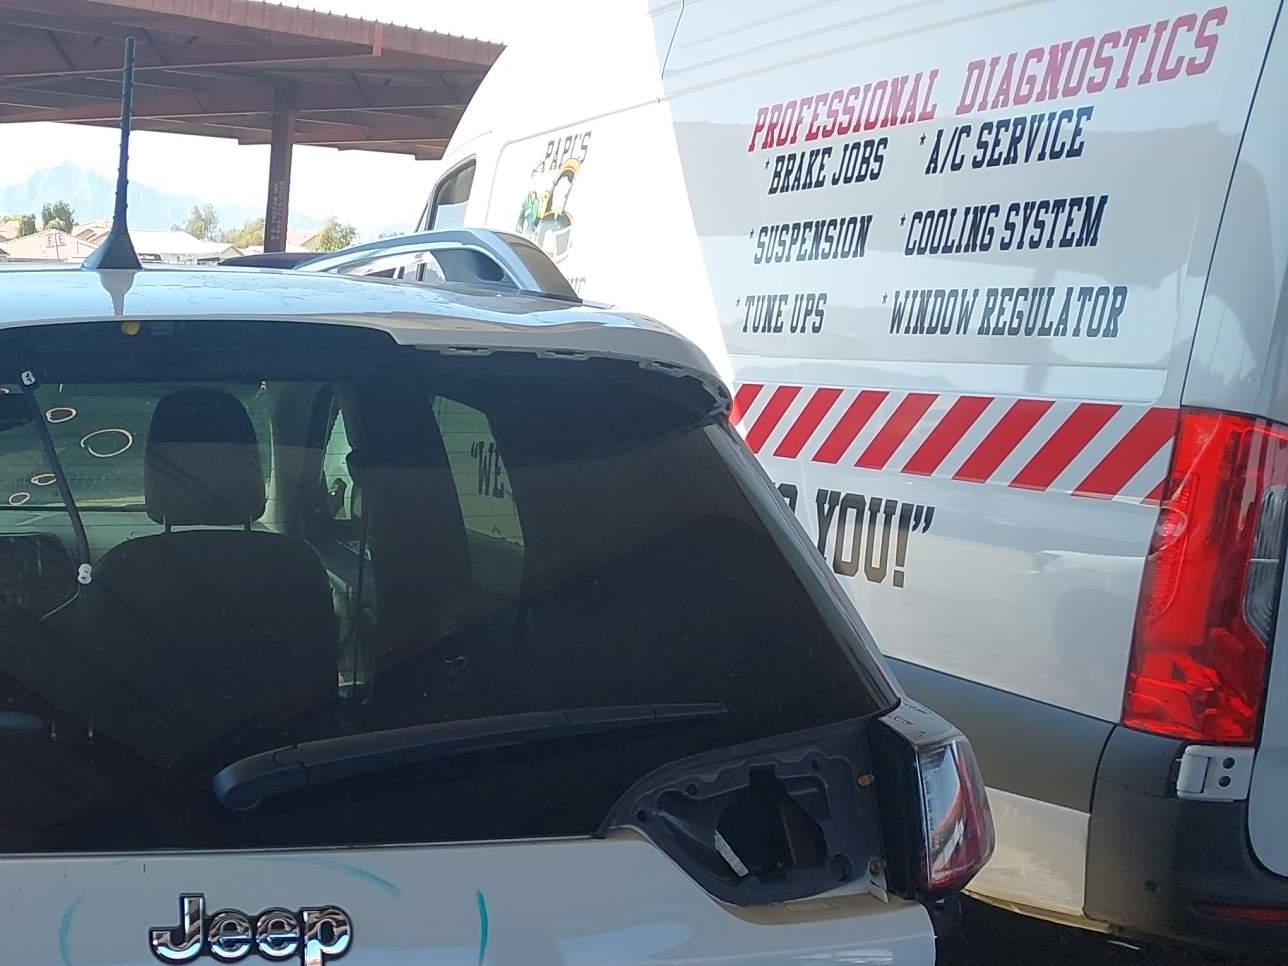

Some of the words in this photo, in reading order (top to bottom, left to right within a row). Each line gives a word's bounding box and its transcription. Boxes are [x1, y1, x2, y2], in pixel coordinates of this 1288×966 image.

[748, 68, 940, 152] PROFESSIONAL
[956, 6, 1228, 116] DIAGNOSTICS
[768, 146, 833, 195] BRAKE
[831, 137, 888, 187] JOBS
[925, 125, 972, 175] A/C
[972, 105, 1095, 169] SERVICE
[754, 214, 874, 265] SUSPENSION
[904, 203, 1000, 256] COOLING
[1000, 195, 1109, 250] SYSTEM
[742, 294, 789, 334] TUNE
[790, 293, 827, 334] UPS
[889, 288, 980, 335] WINDOW
[977, 286, 1128, 338] REGULATOR
